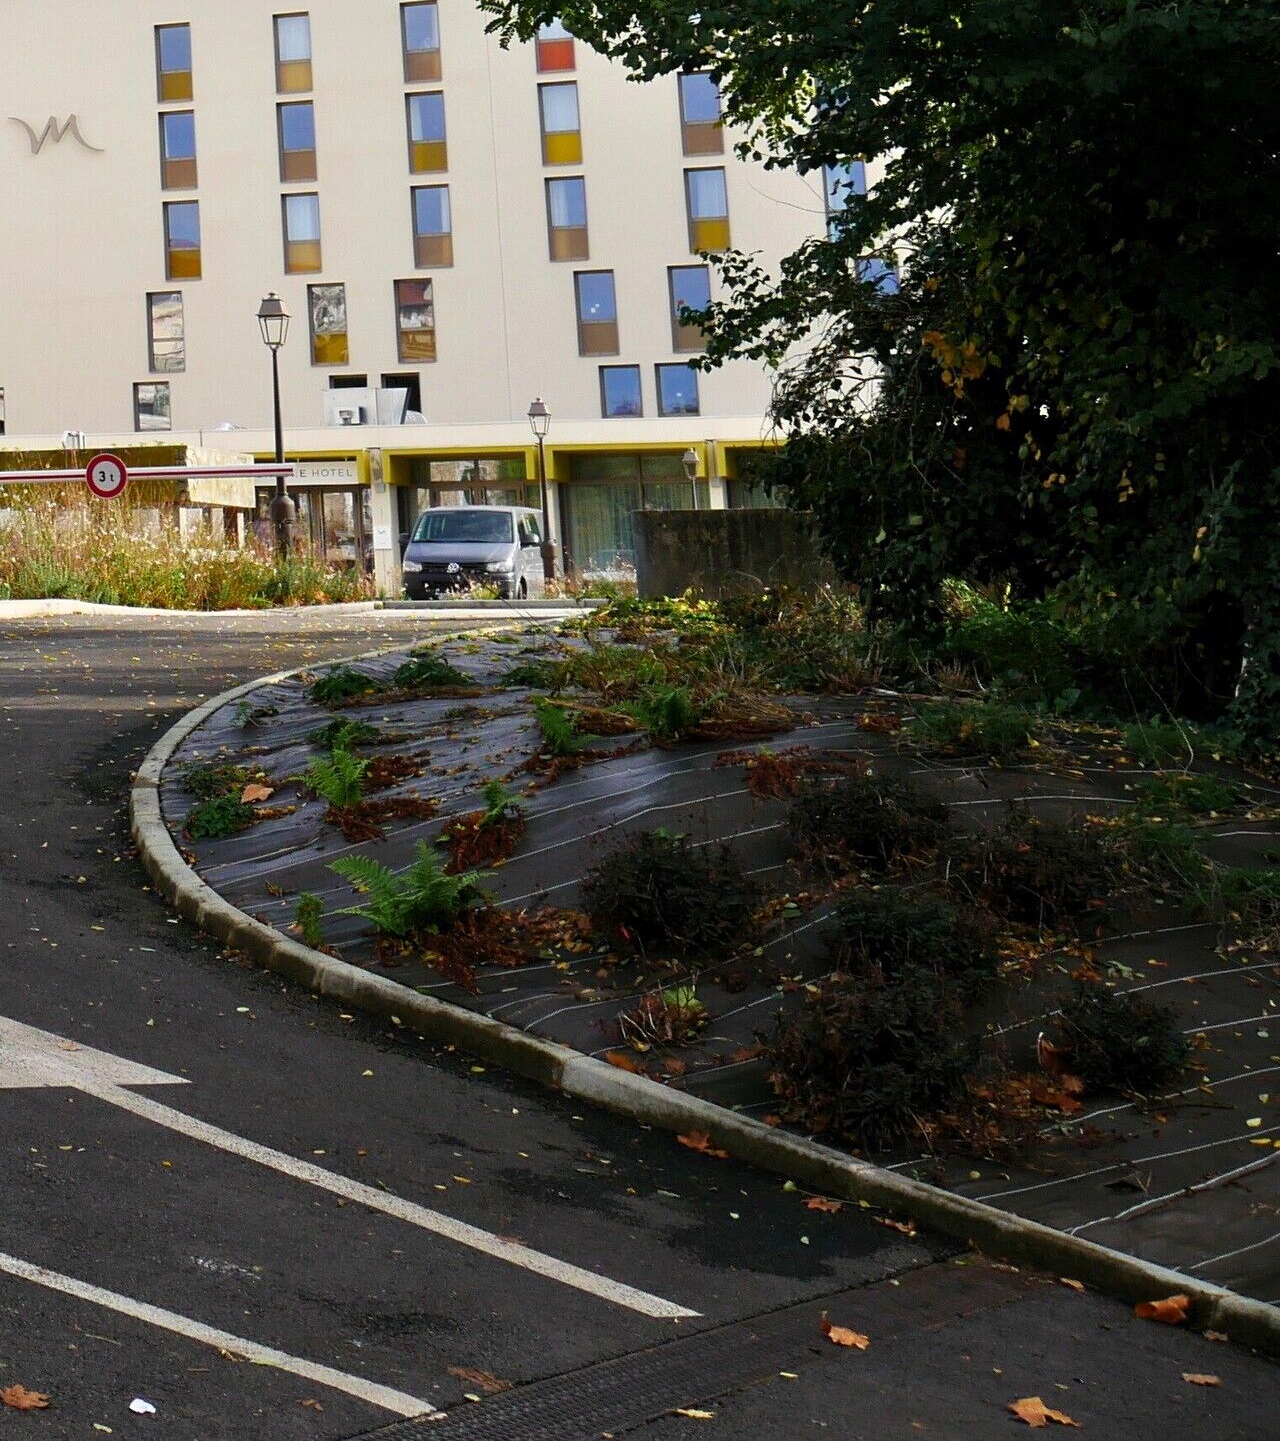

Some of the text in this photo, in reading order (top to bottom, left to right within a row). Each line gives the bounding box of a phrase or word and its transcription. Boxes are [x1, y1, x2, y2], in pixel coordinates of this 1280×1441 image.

[98, 470, 115, 483] 3 t
[312, 468, 353, 479] HOTEL
